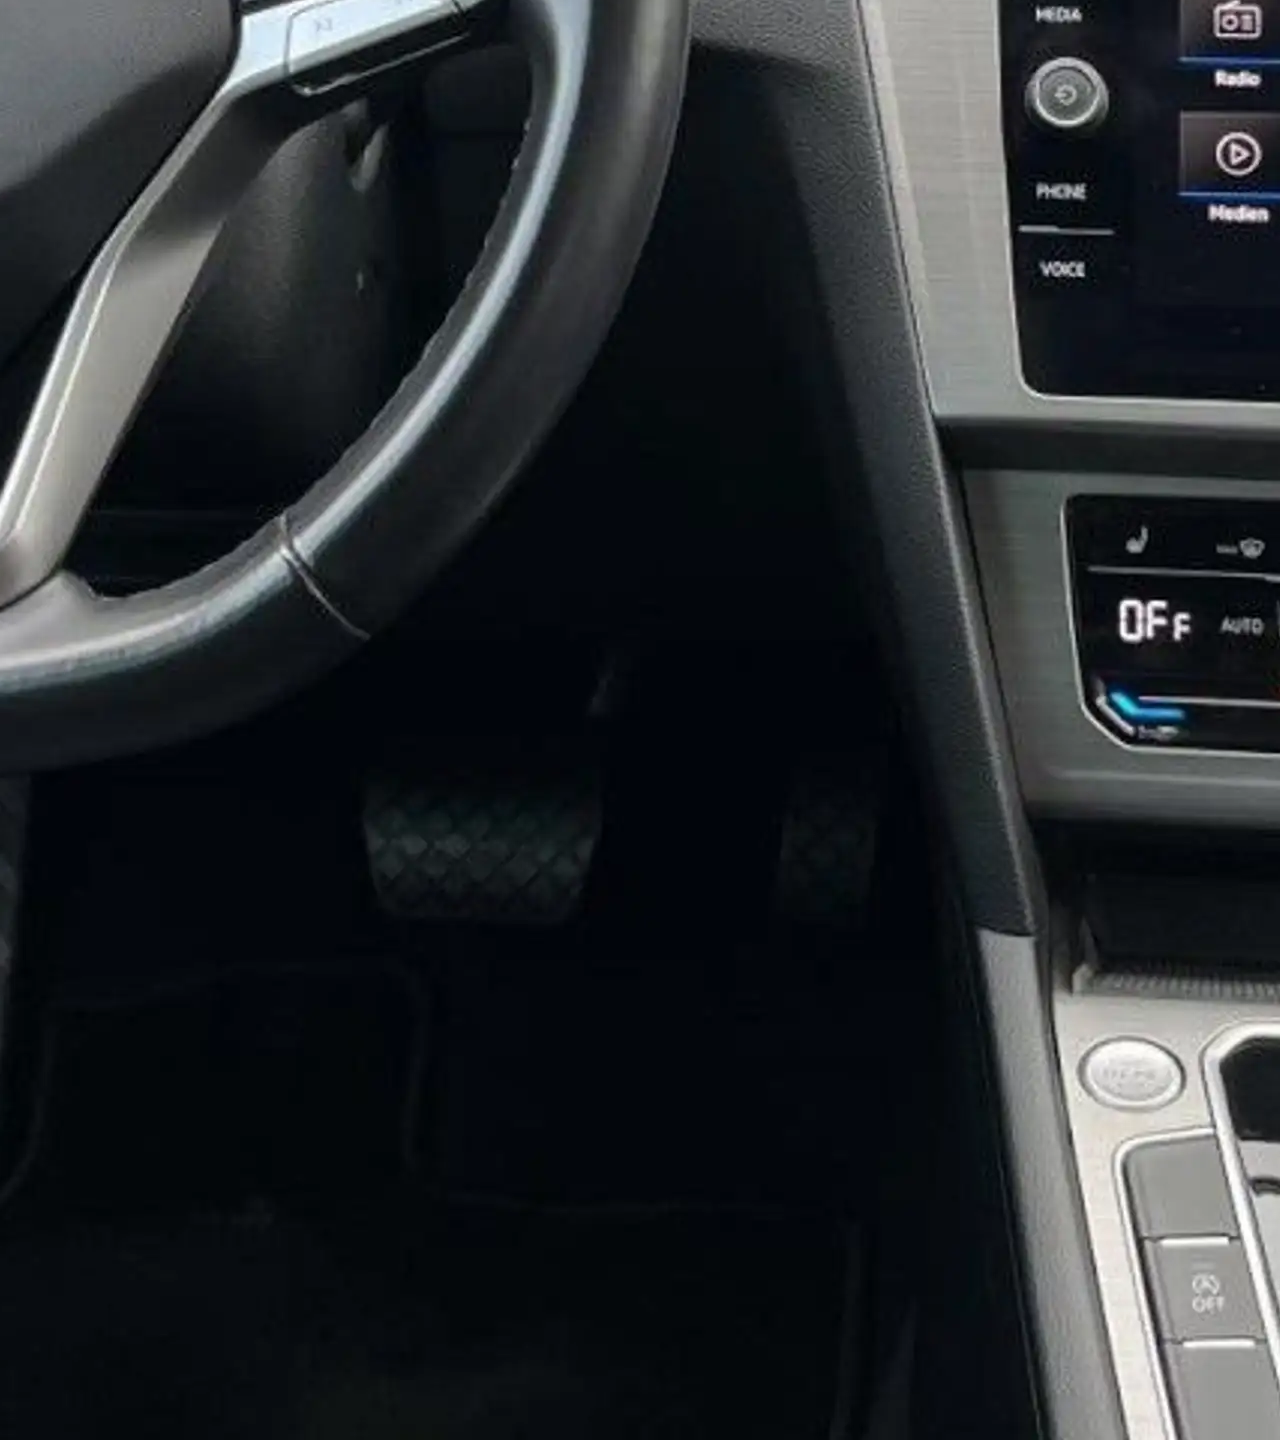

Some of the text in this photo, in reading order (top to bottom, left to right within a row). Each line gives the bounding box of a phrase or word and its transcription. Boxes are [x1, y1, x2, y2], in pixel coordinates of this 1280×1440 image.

[1035, 6, 1083, 23] MEDIA
[1214, 69, 1262, 87] Radio
[1036, 182, 1088, 200] PHONE
[1208, 205, 1270, 224] Medien
[1039, 261, 1086, 278] VOICE
[1221, 616, 1266, 635] AUTO
